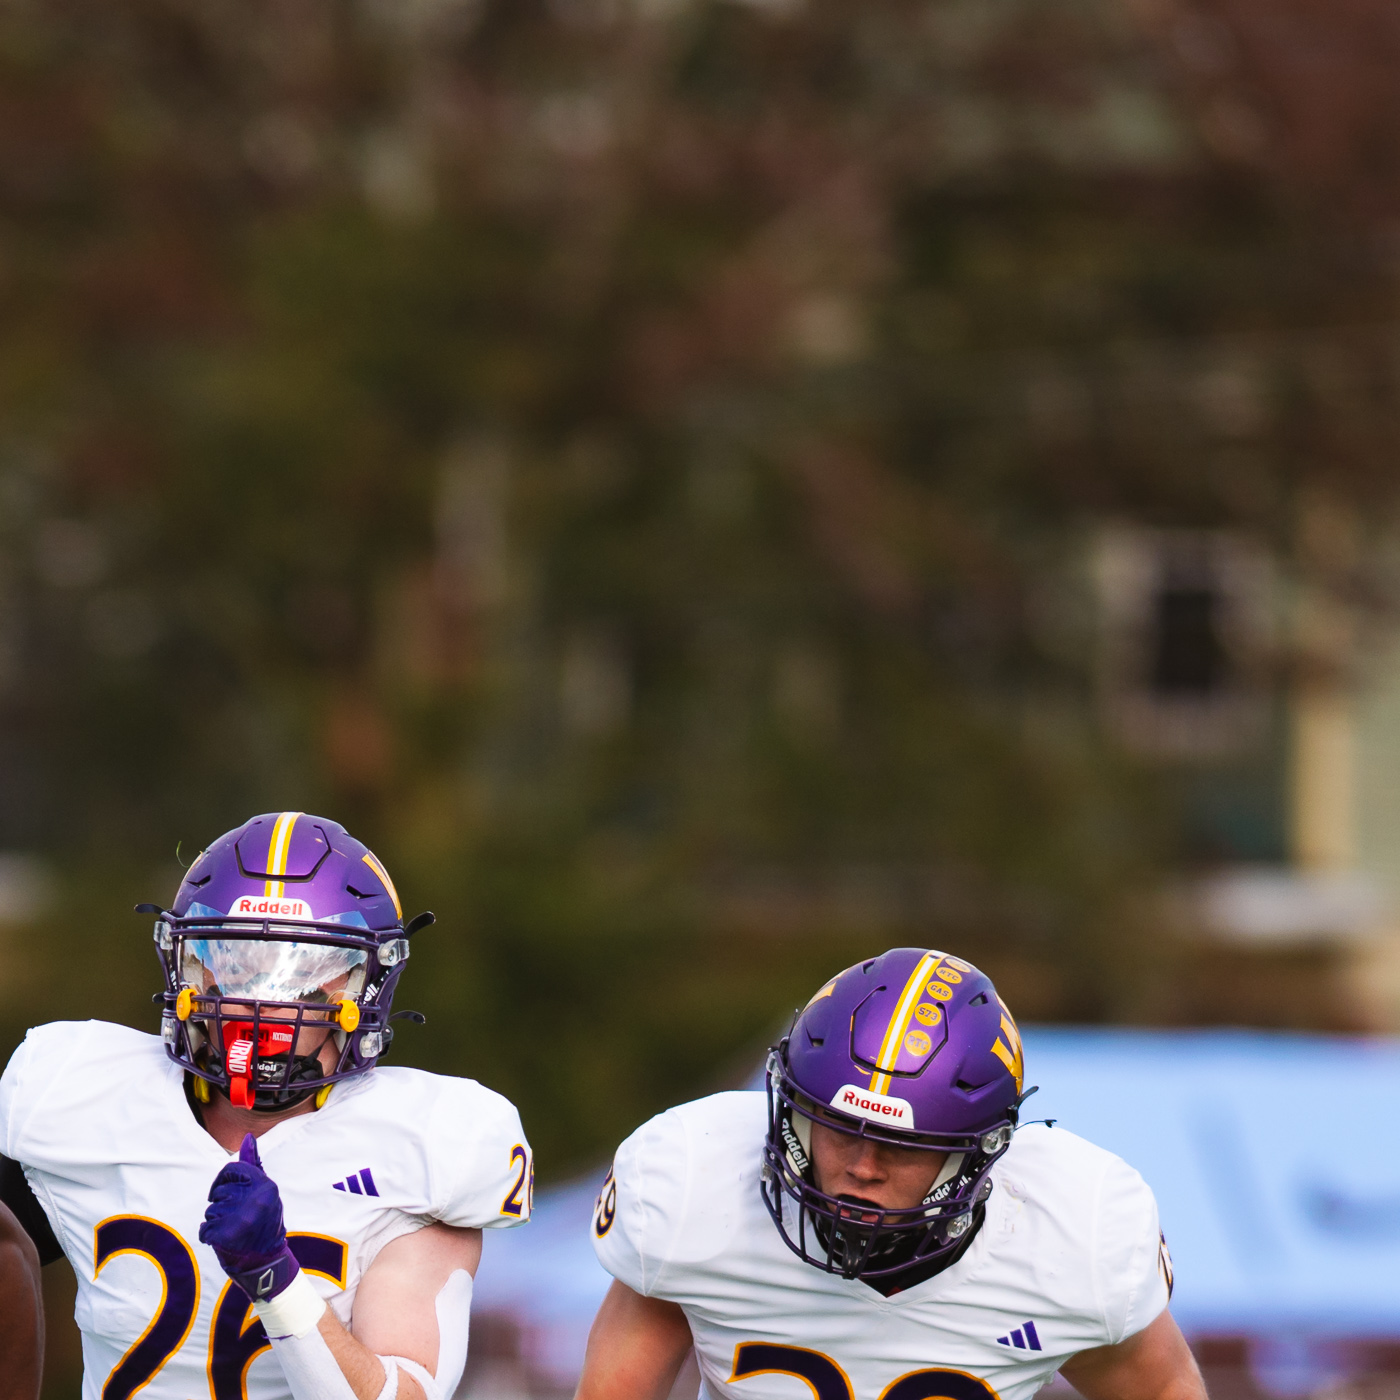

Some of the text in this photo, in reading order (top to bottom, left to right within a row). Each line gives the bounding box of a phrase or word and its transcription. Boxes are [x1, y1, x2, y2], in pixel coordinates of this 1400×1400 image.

[239, 899, 303, 916] Riddell
[930, 984, 949, 997] GAS
[907, 1034, 929, 1051] RTC
[842, 1090, 905, 1118] Riddell
[922, 1174, 969, 1206] Riddll
